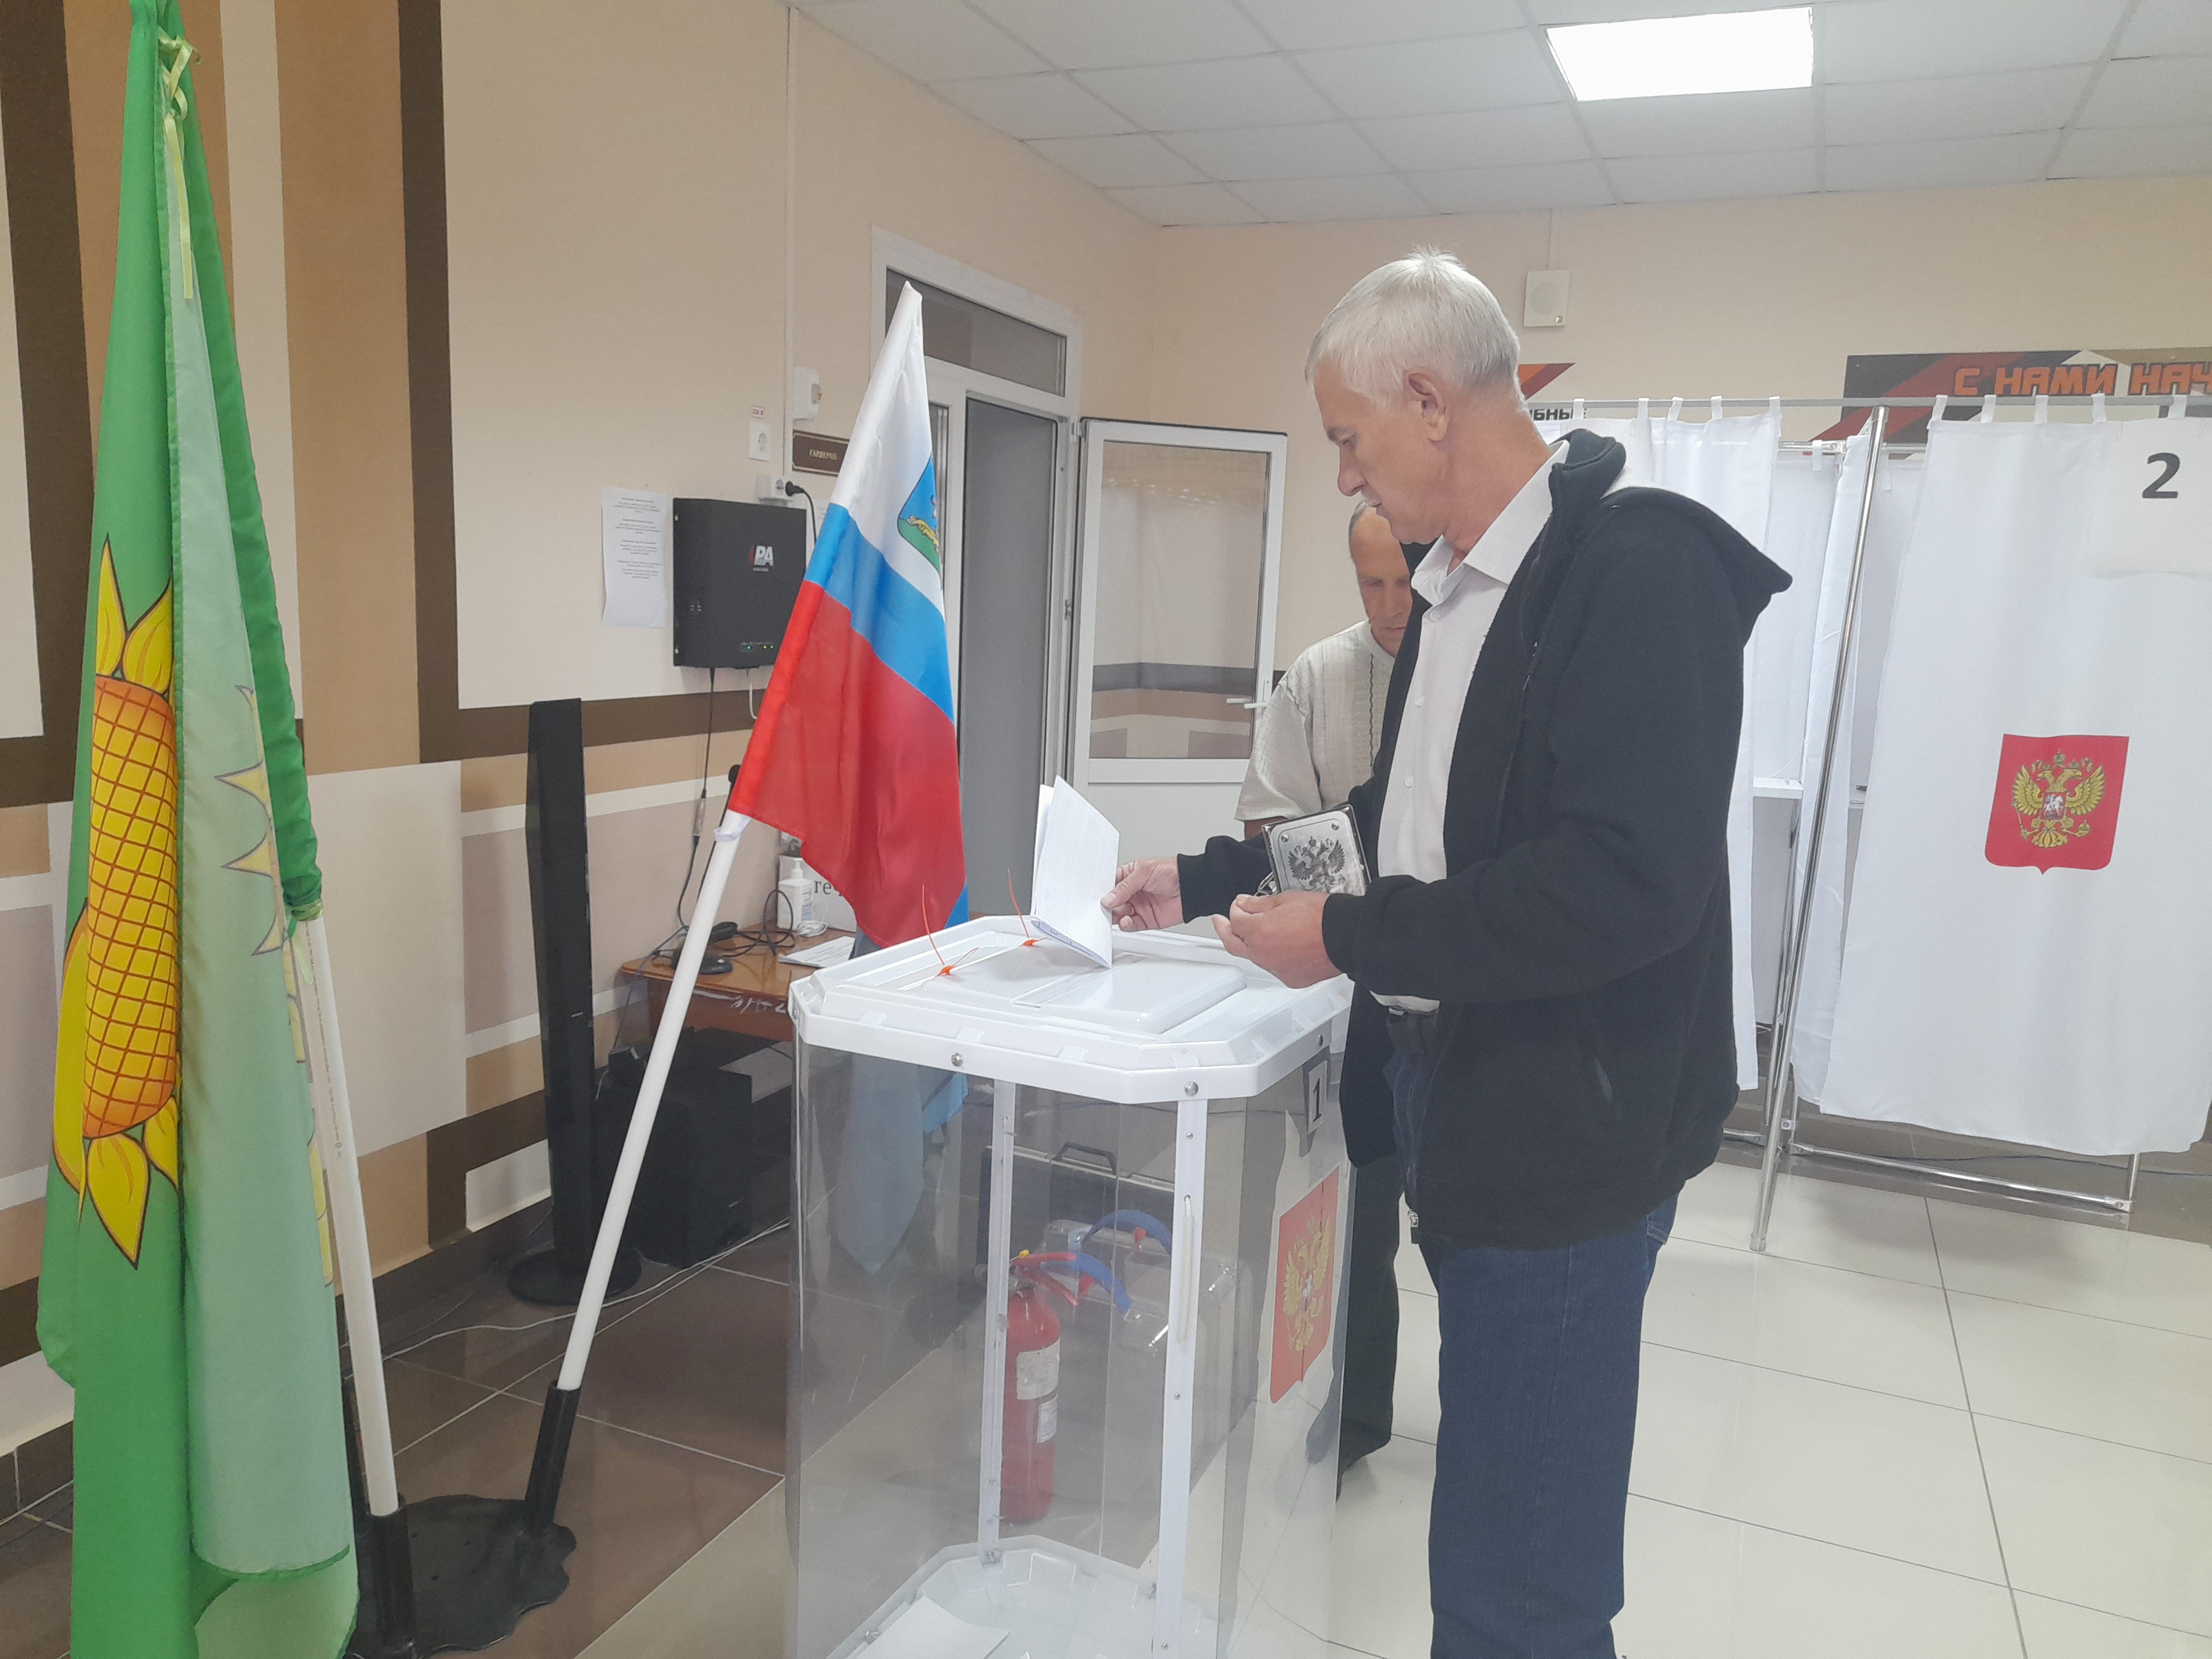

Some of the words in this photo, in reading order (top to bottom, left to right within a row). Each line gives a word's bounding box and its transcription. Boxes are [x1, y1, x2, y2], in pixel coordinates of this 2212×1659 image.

[1954, 367, 1981, 396] С
[1994, 365, 2117, 396] НАМИ
[2142, 452, 2180, 498] 2
[1313, 1077, 1322, 1123] 1
